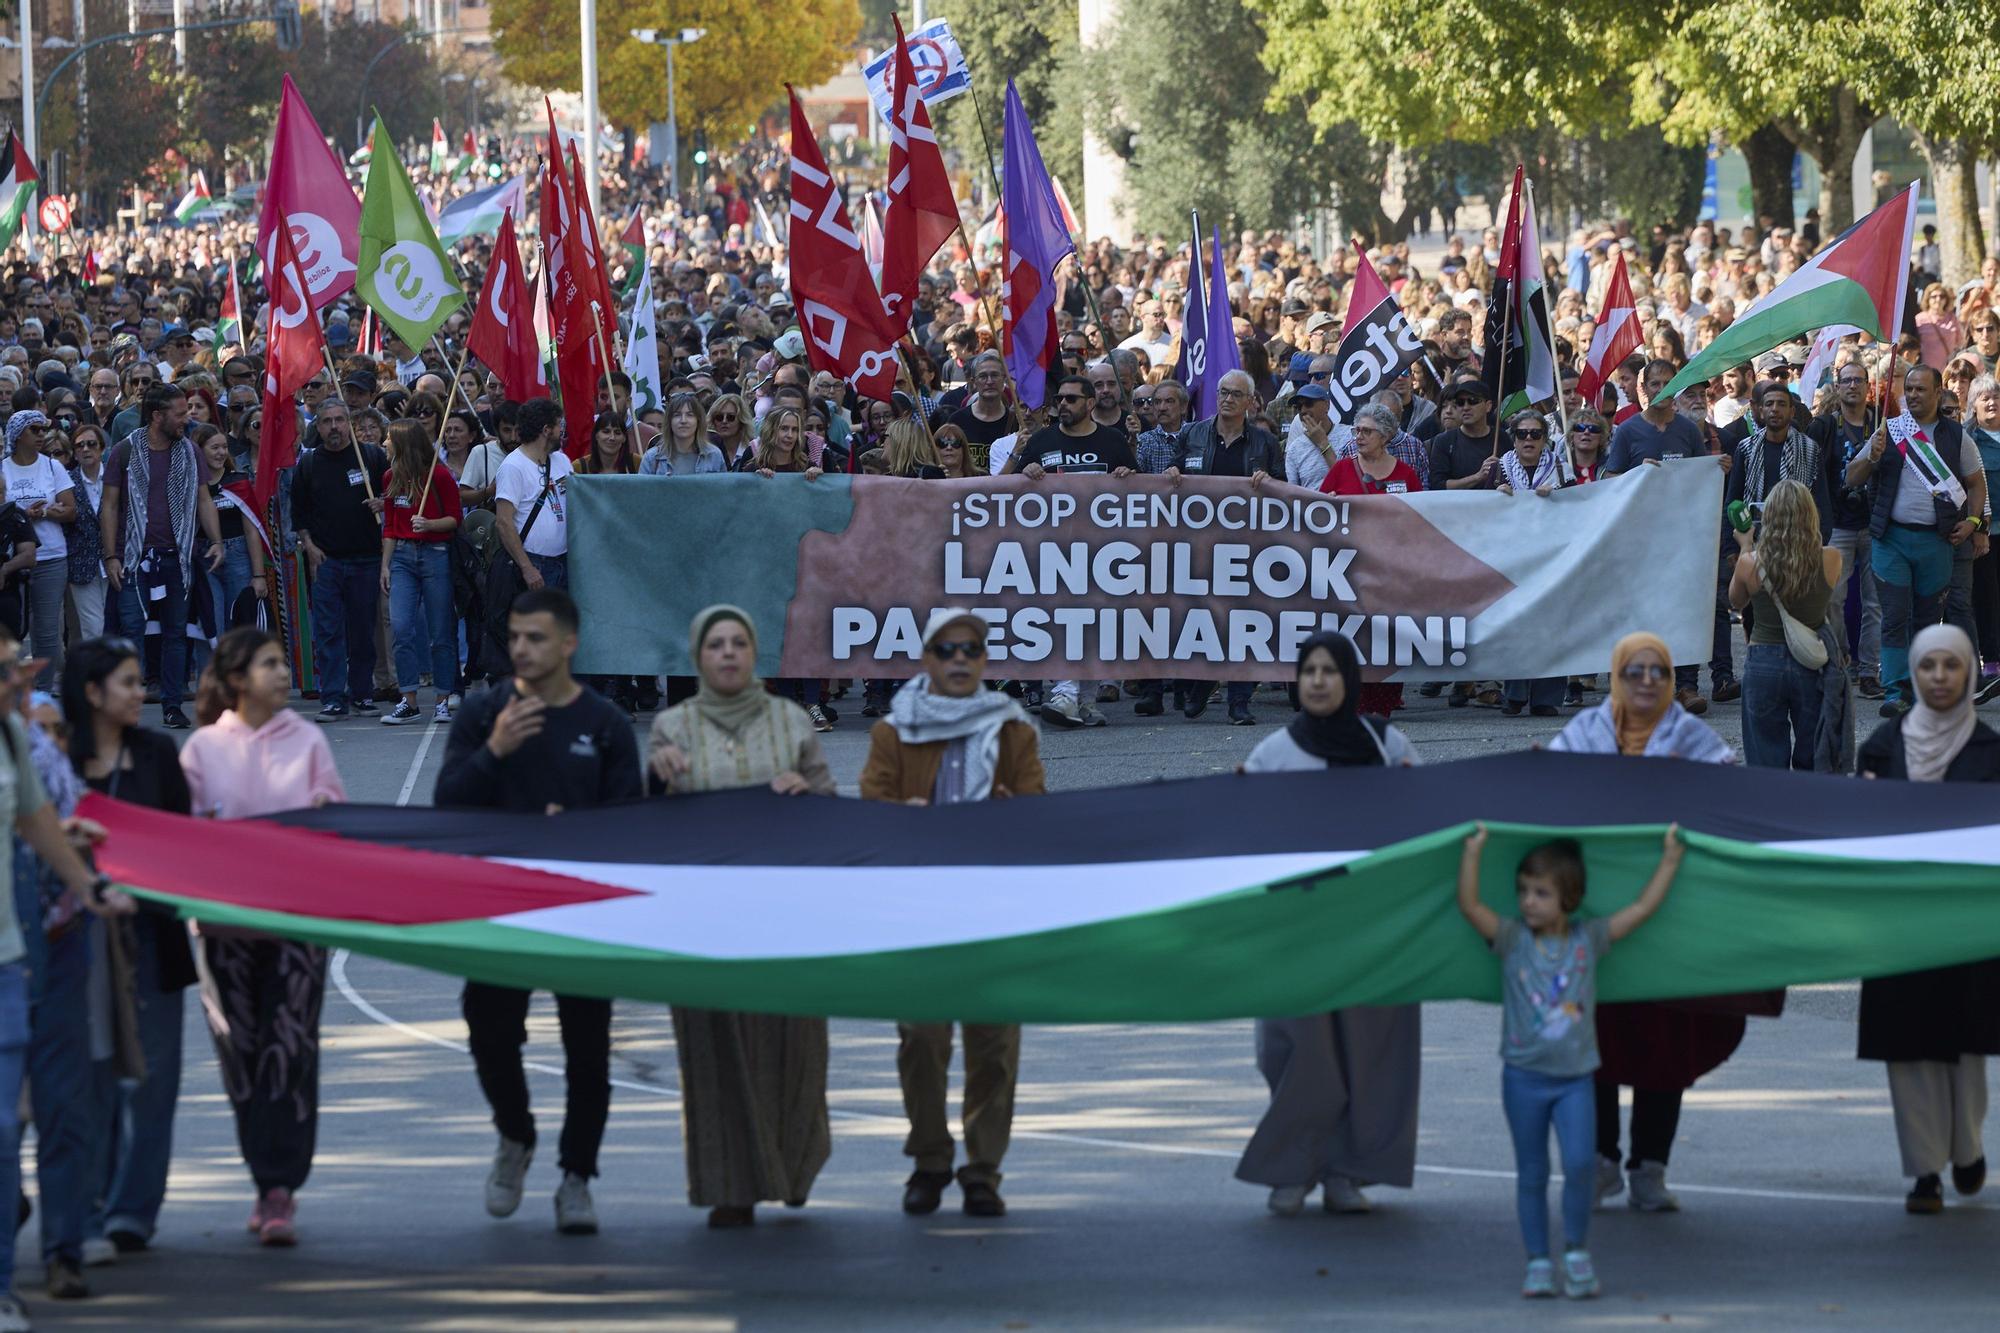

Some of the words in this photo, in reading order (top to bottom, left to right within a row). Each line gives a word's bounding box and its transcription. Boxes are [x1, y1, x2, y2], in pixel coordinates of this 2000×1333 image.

[1065, 452, 1098, 464] NO
[952, 493, 1077, 536] ¡STOP
[1090, 493, 1350, 535] GENOCIDIO!
[945, 541, 1358, 601] LANGILEOK
[832, 607, 1467, 667] PAESTINAREKIN!
